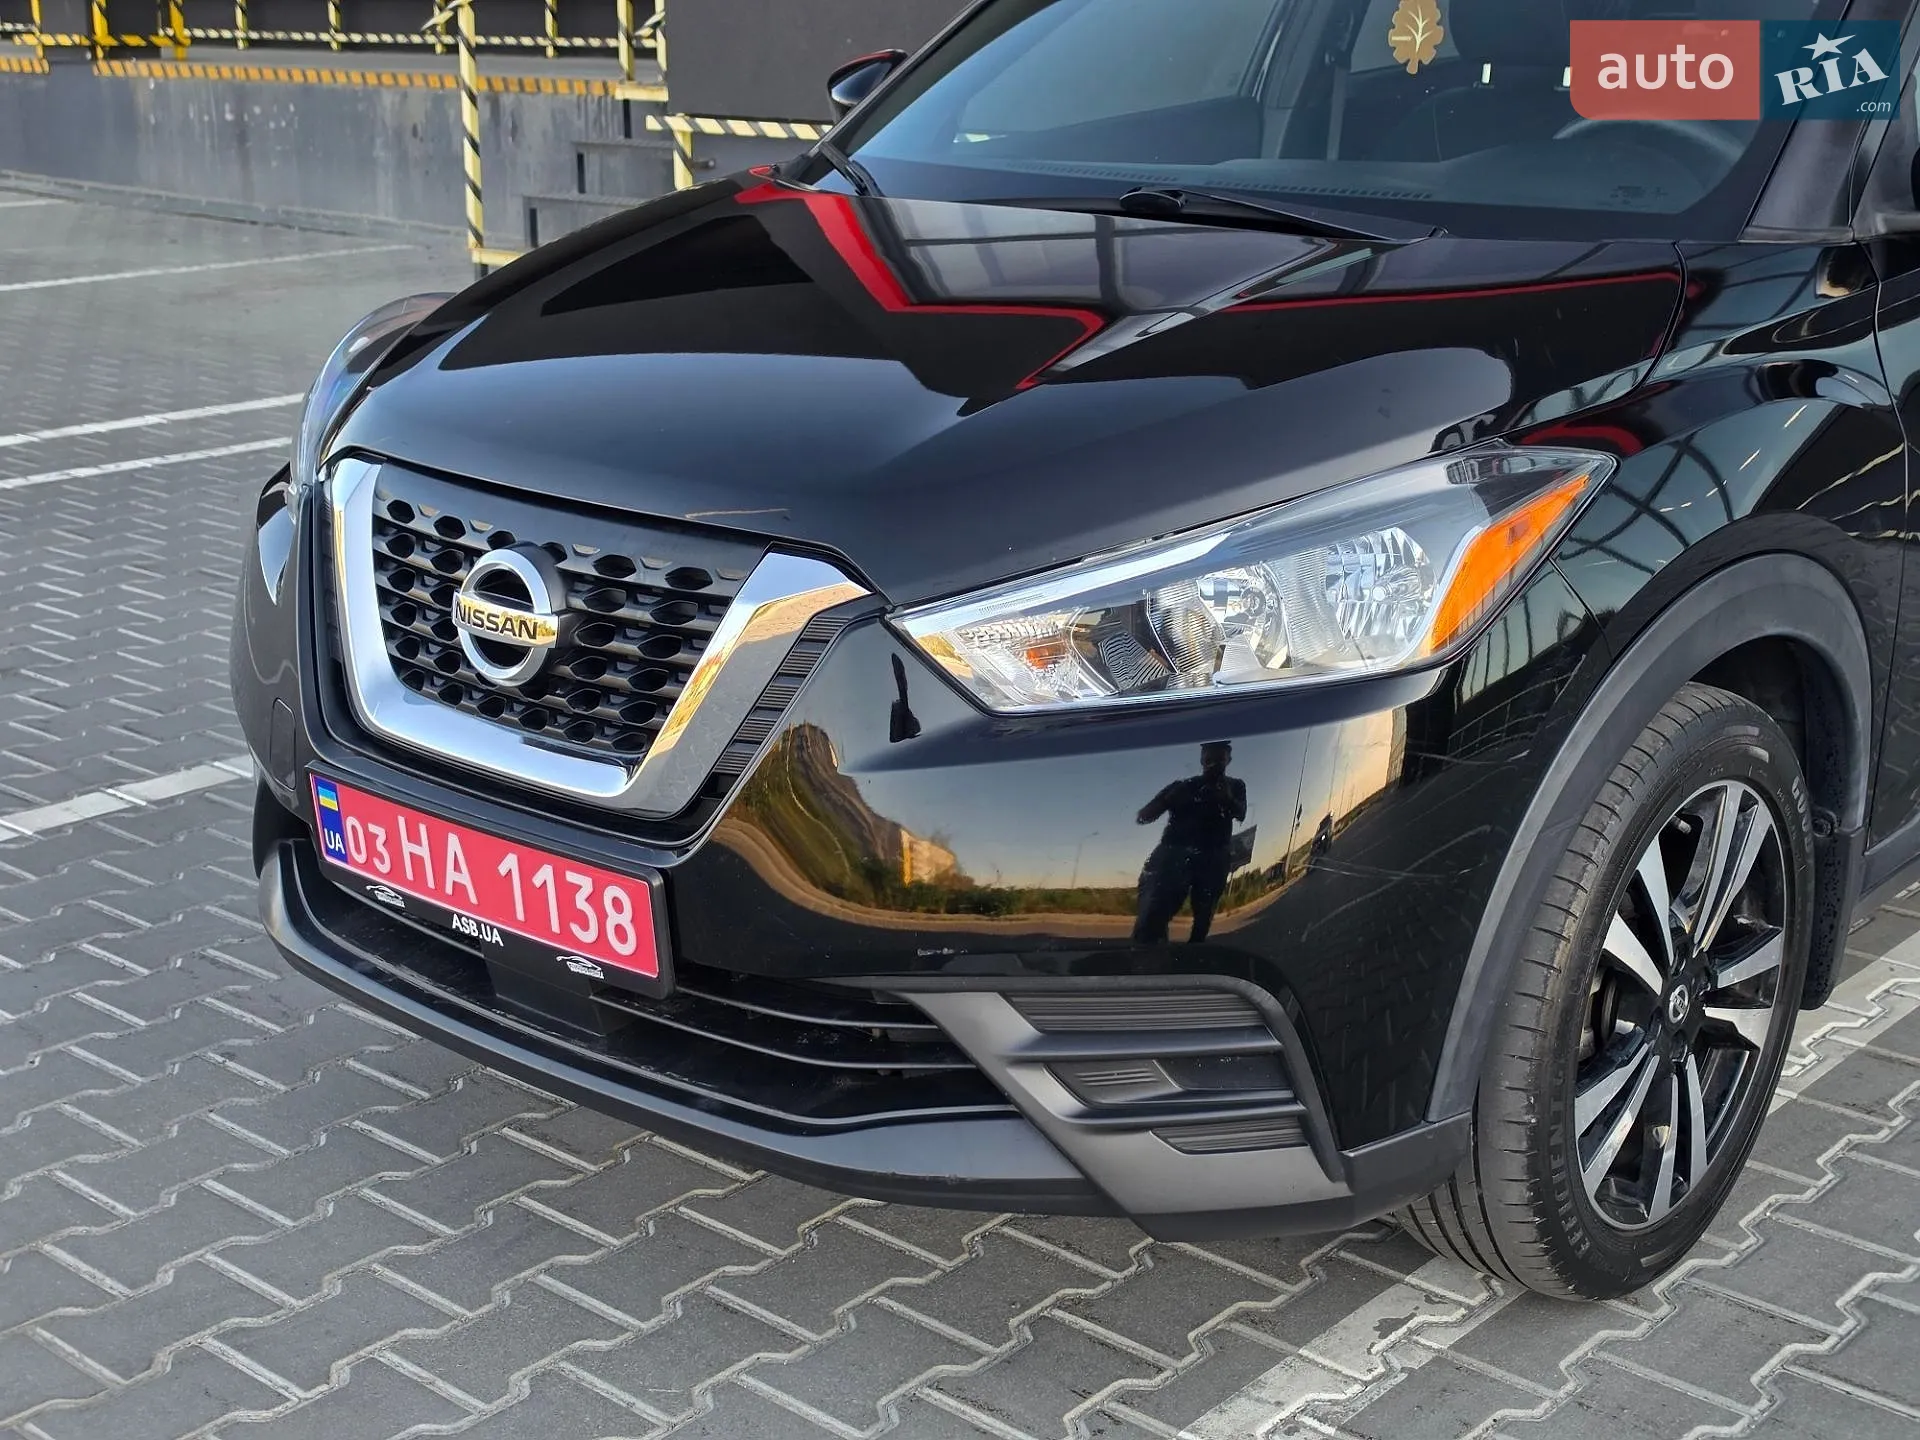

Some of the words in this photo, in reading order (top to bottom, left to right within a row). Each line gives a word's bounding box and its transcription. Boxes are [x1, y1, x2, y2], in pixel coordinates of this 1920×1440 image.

[454, 599, 539, 640] NISSAN
[324, 827, 346, 854] UA
[345, 815, 392, 875] 03
[397, 815, 479, 905] HA
[497, 852, 638, 957] 1138
[452, 913, 504, 947] ASB.UA
